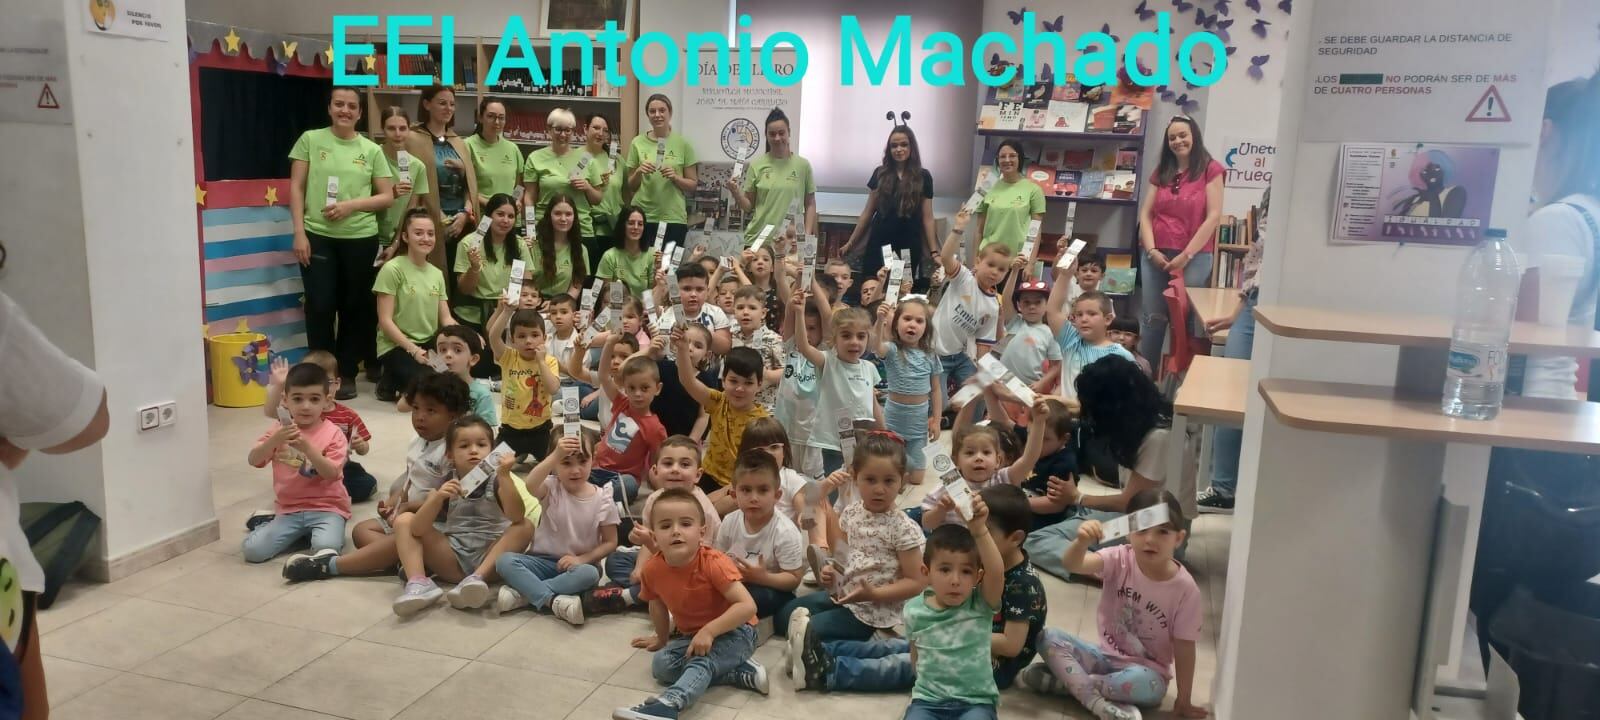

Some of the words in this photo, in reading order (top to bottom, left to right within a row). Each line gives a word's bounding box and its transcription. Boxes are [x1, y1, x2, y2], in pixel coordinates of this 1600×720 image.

[1323, 36, 1337, 45] SE
[1340, 36, 1367, 45] DEBE
[1369, 35, 1421, 44] GUARDAR
[1423, 34, 1437, 43] LA
[1438, 33, 1495, 43] DISTANCIA
[1497, 33, 1513, 42] DE
[1318, 47, 1378, 56] SEGURIDAD
[1385, 75, 1401, 84] NO
[1404, 74, 1448, 84] PODRÁN
[1450, 74, 1473, 83] SER
[1475, 74, 1490, 83] DE
[1314, 86, 1329, 95] DE
[1331, 86, 1372, 95] CUATRO
[1375, 86, 1432, 95] PERSONAS
[1254, 157, 1266, 168] al
